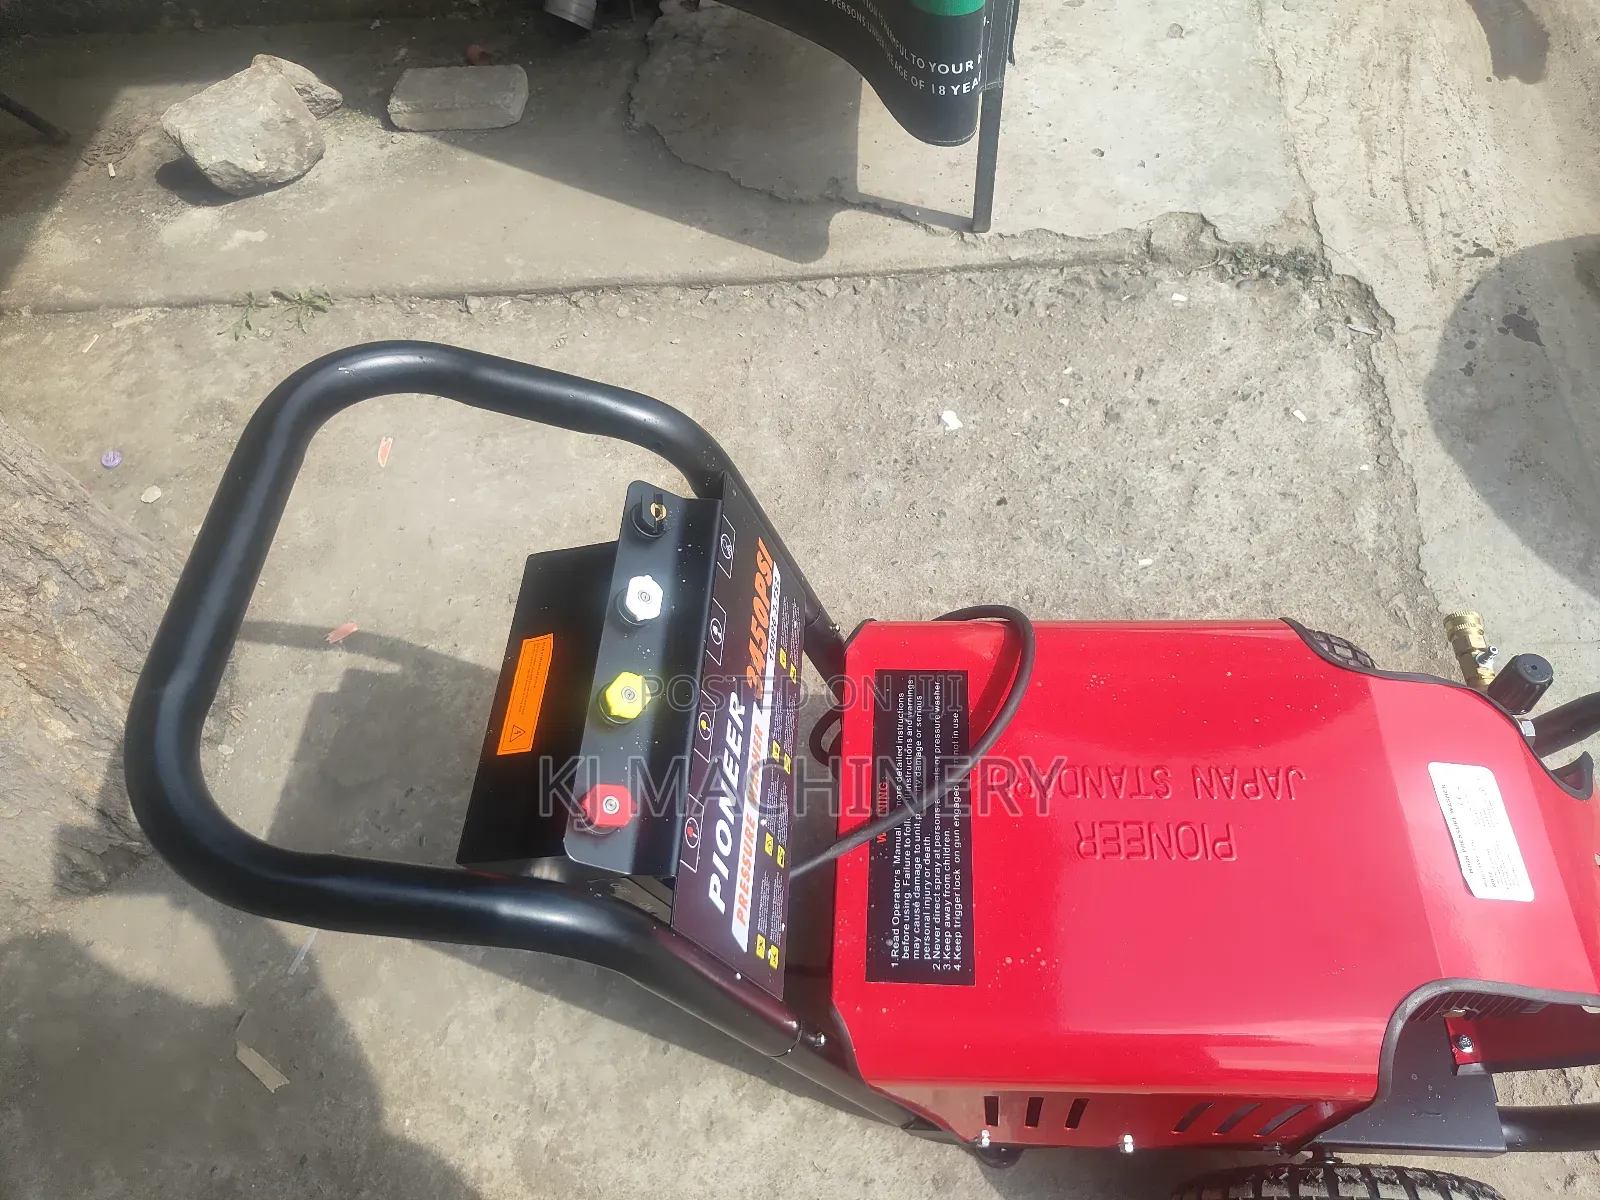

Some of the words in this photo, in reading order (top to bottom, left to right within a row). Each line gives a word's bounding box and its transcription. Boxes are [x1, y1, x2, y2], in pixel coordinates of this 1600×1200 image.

[832, 0, 865, 26] PERSONS
[894, 61, 908, 81] AGE
[911, 76, 925, 89] OF
[932, 84, 946, 95] 18
[911, 53, 925, 69] TO
[928, 60, 974, 74] YOUR
[746, 536, 775, 700] 3450PSI
[896, 693, 904, 743] instructions
[916, 730, 921, 738] or
[933, 715, 941, 753] pressure
[915, 741, 923, 777] damage
[934, 756, 940, 764] or
[1191, 763, 1307, 800] JAPAN
[708, 692, 746, 915] PIONEER
[736, 811, 756, 927] PRESSURE
[747, 722, 764, 804] WASHER
[954, 829, 962, 847] gun
[1074, 820, 1238, 861] PIONEER
[893, 827, 901, 864] Manual
[904, 838, 910, 847] to
[913, 844, 920, 853] to
[923, 833, 931, 865] death.
[934, 849, 940, 859] at
[954, 851, 960, 863] on
[903, 850, 911, 886] Failure
[913, 857, 922, 898] damage
[925, 867, 931, 877] or
[934, 861, 942, 890] spray
[953, 869, 961, 889] lock
[892, 869, 901, 925] Operator's
[923, 880, 932, 909] injury
[943, 874, 951, 897] from
[903, 890, 912, 920] using.
[954, 892, 962, 928] trigger
[902, 924, 910, 959] before
[913, 936, 921, 959] may
[923, 912, 931, 959] personal
